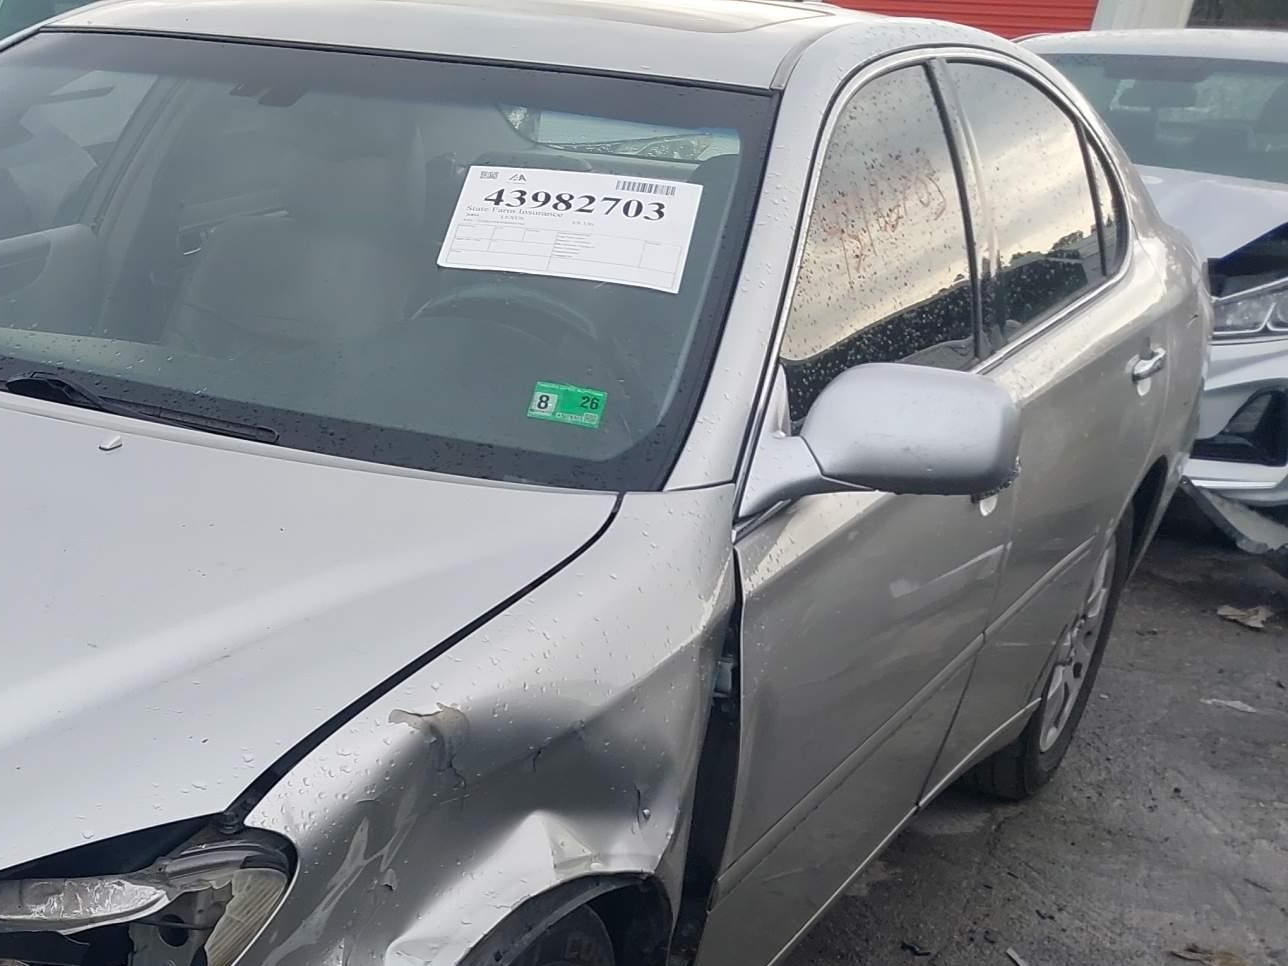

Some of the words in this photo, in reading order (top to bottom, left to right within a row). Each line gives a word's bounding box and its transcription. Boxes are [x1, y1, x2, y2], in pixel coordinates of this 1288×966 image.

[483, 187, 666, 221] 43982703
[492, 205, 516, 214] Farm
[519, 208, 565, 218] Insurance
[537, 394, 550, 410] 8
[580, 396, 600, 410] 26
